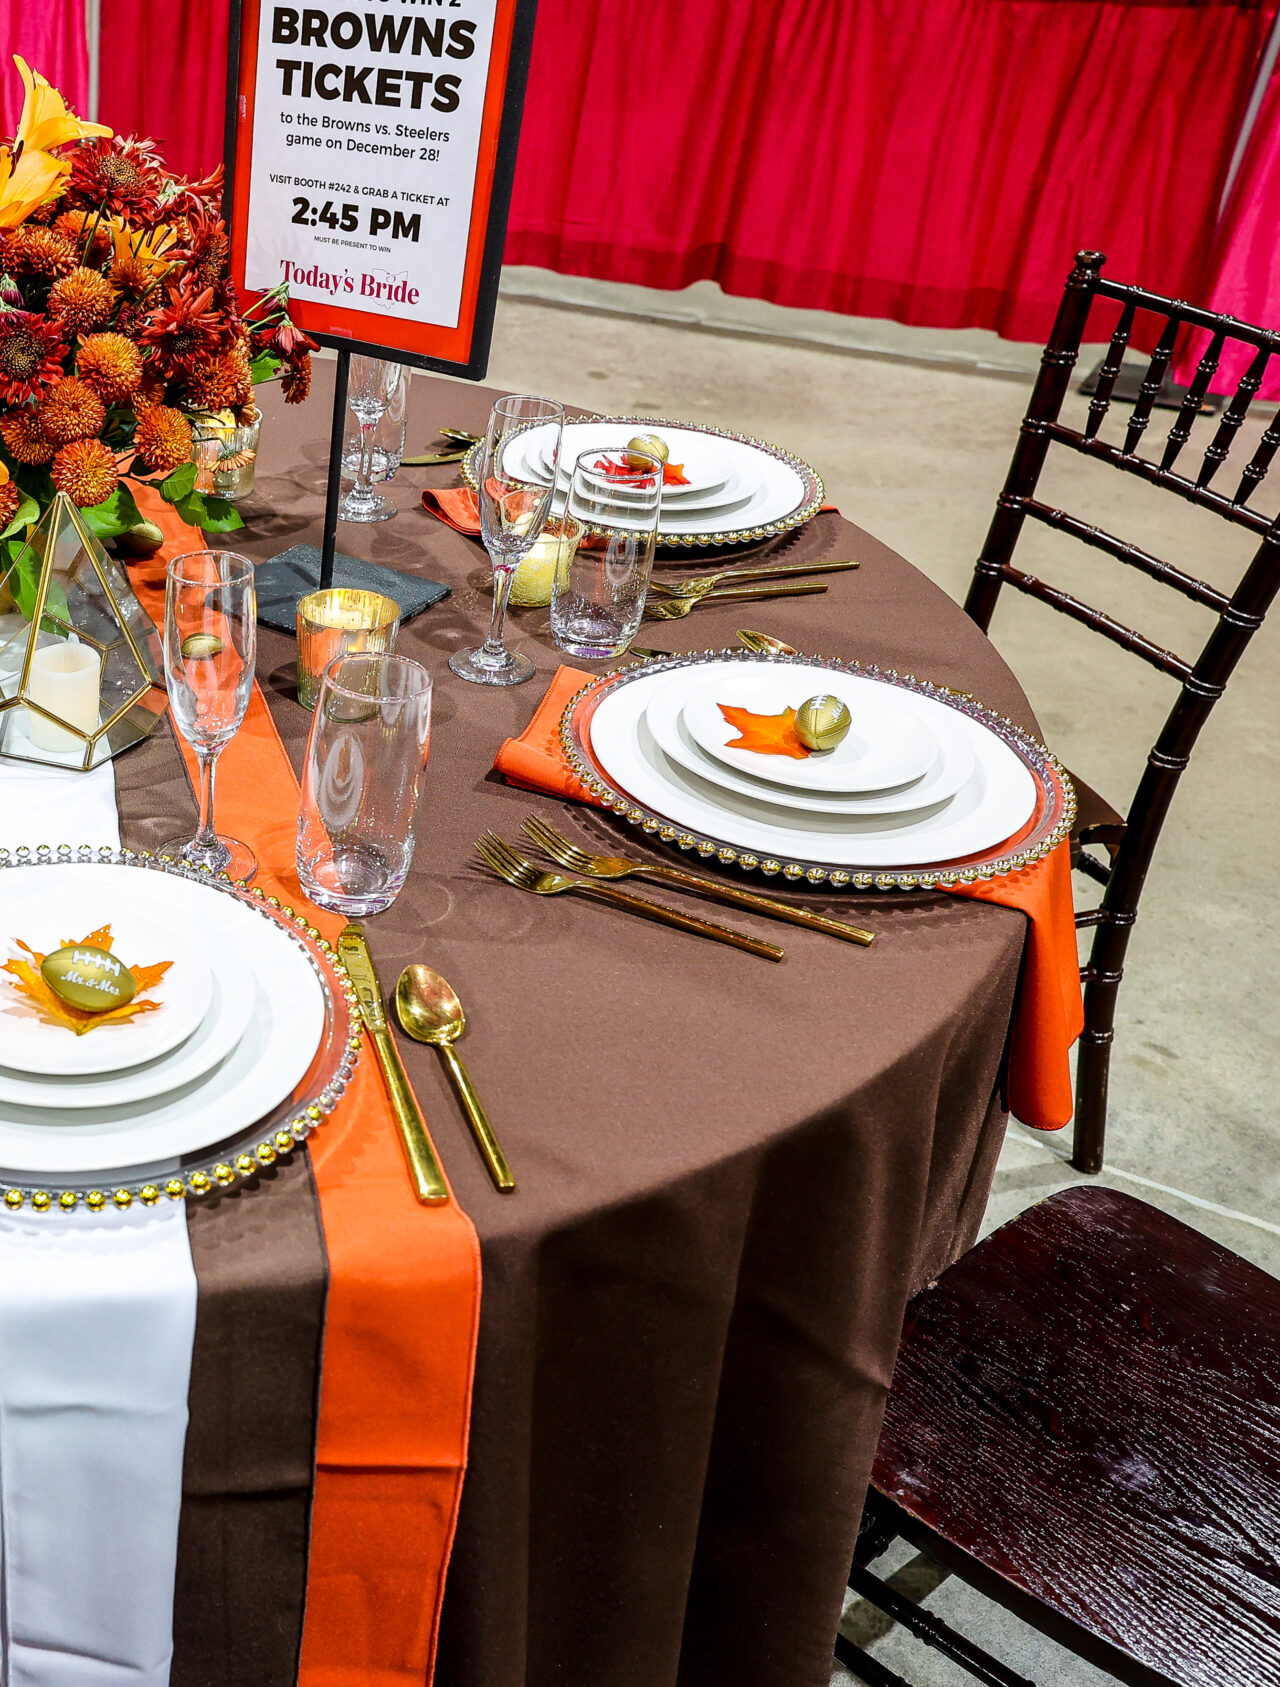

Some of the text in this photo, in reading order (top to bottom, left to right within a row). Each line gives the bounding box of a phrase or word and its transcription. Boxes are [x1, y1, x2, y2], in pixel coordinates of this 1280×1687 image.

[271, 6, 478, 60] BROWNS
[275, 58, 463, 114] TICKETS
[280, 111, 450, 143] to the Browns vs. Steelers
[285, 133, 440, 162] game on December 28!
[269, 173, 451, 207] VISIT BOOTH #242 & GRAB A TICKET AT
[291, 196, 422, 243] 2:45 PM
[313, 235, 392, 253] MUST BE PRESENT TO WIN
[279, 258, 420, 305] Today's Bride
